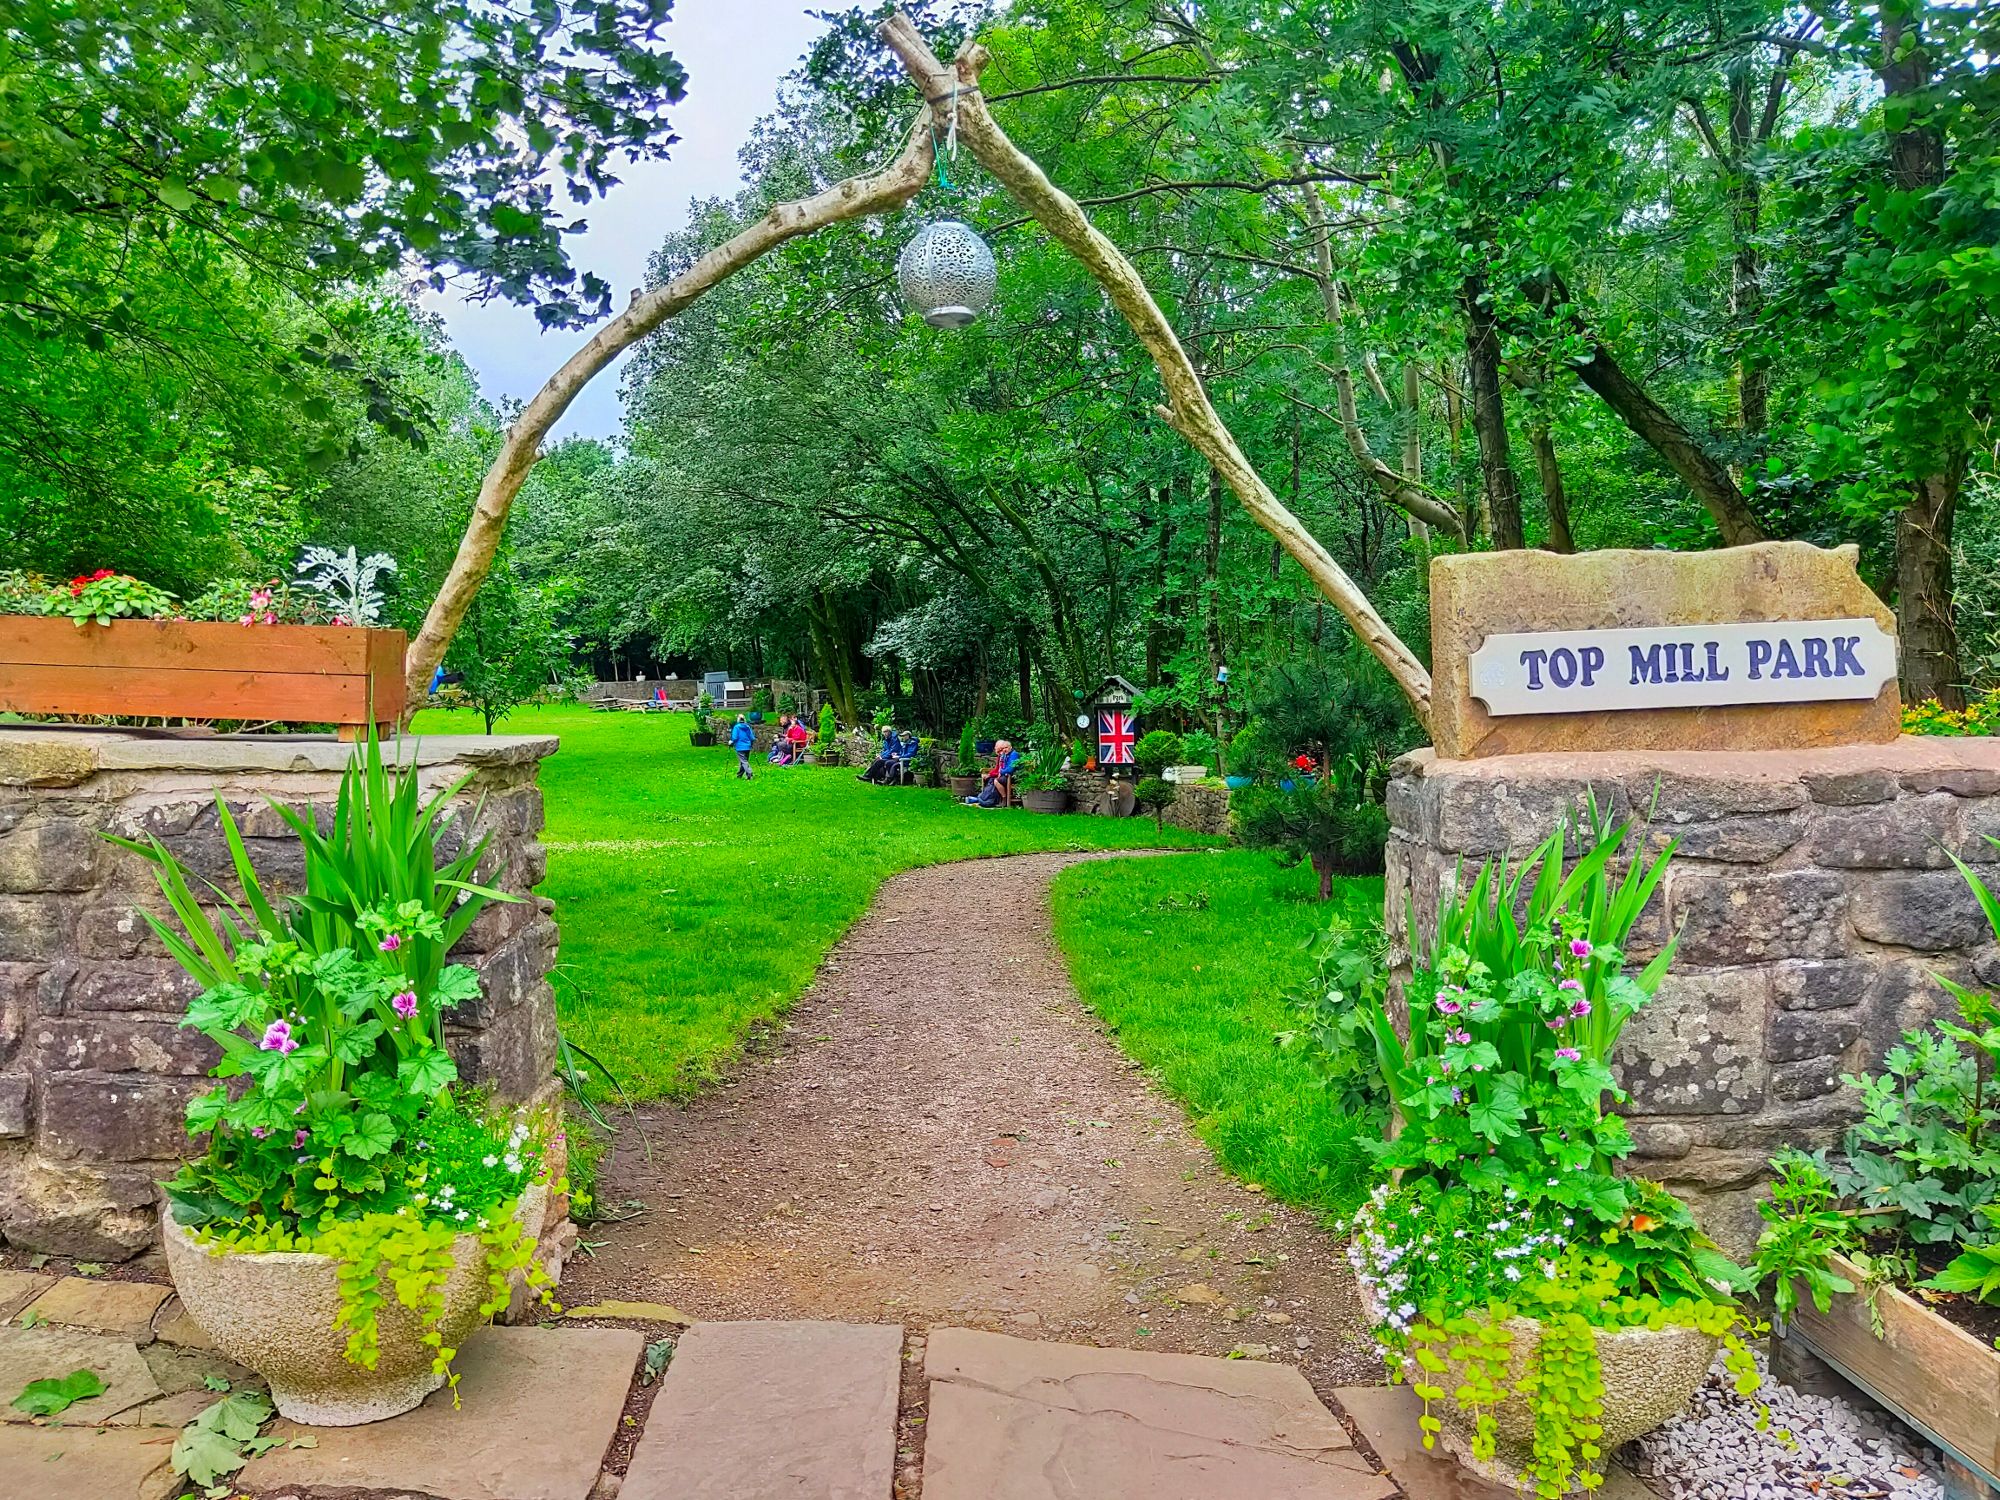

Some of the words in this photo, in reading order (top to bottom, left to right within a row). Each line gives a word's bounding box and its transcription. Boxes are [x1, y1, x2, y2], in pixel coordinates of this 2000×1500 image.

[1520, 645, 1605, 690] TOP
[1628, 641, 1729, 684] MILL
[1746, 636, 1866, 680] PARK
